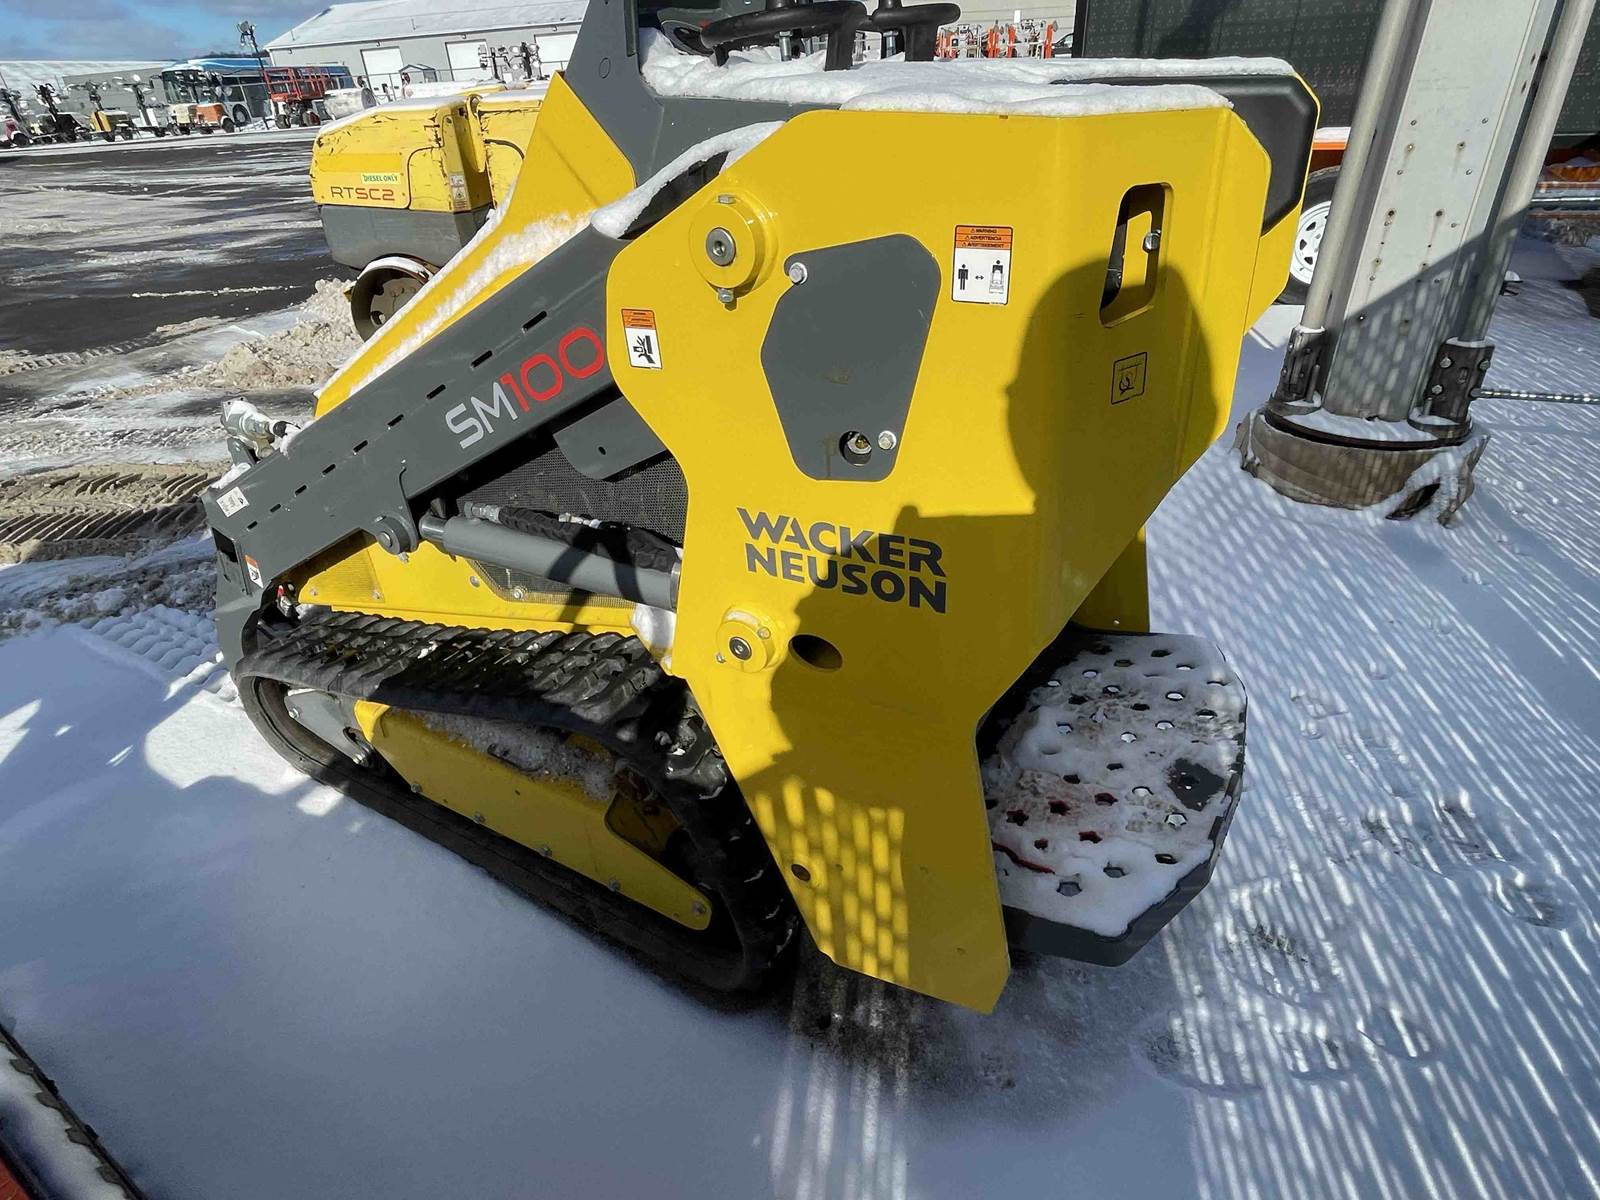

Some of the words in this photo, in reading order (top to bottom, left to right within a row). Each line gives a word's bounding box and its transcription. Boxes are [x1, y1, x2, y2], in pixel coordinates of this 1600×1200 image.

[330, 186, 395, 201] RTSC2
[363, 174, 383, 182] DIESEL
[383, 174, 398, 182] ONLY
[445, 326, 605, 449] SM100
[736, 507, 946, 577] WACKER
[745, 543, 947, 614] NEUSON
